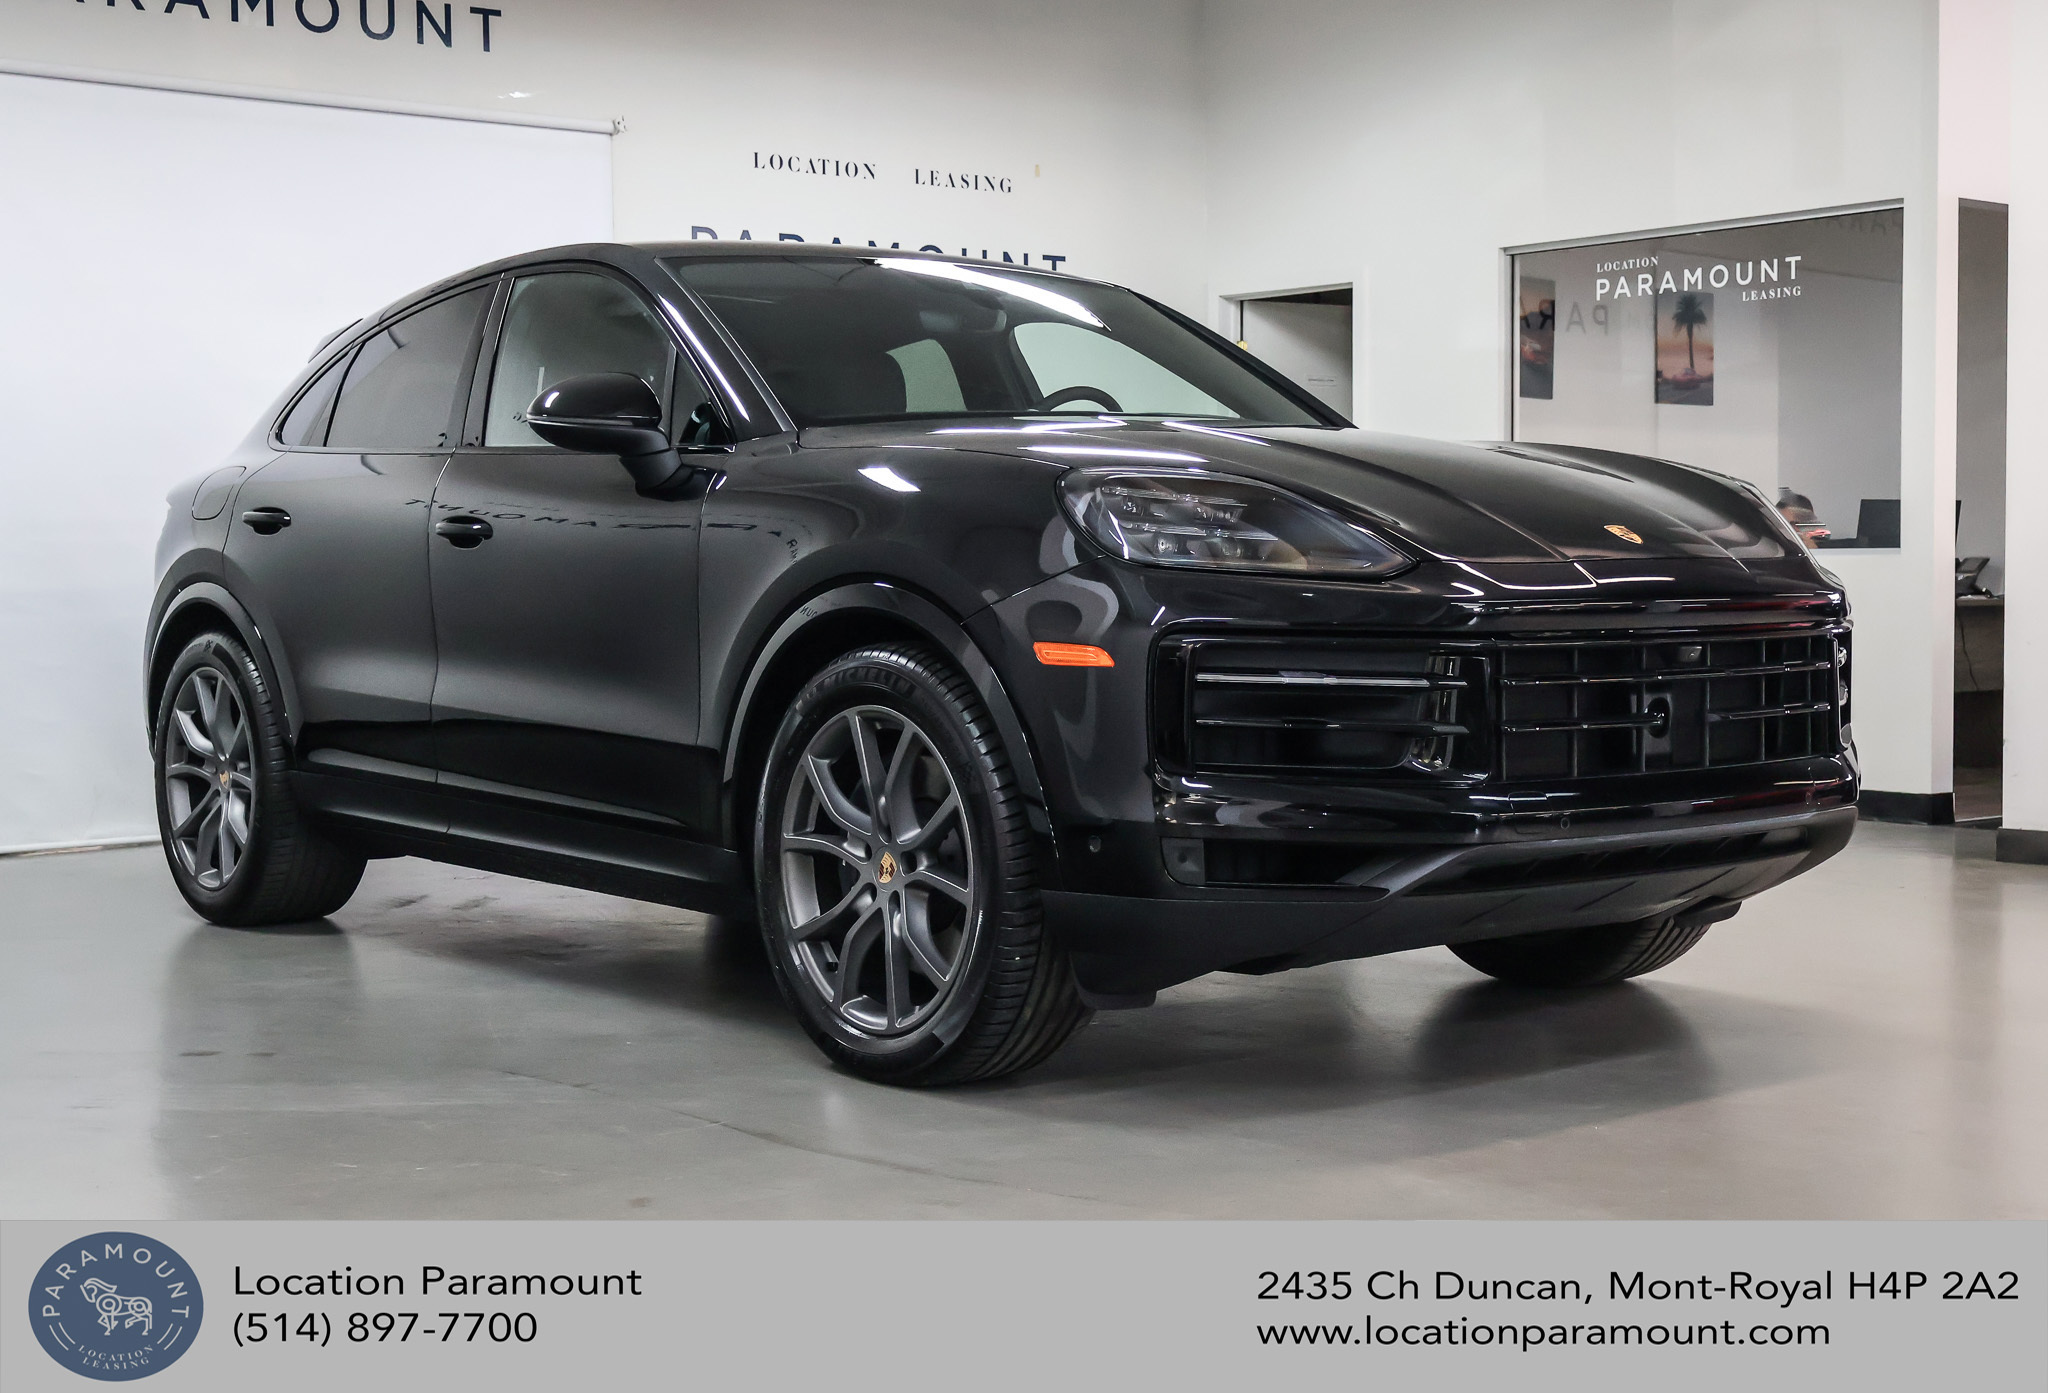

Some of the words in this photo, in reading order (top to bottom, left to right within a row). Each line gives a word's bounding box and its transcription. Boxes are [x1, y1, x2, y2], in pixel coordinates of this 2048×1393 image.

[753, 151, 877, 180] LOCATION
[914, 168, 1013, 194] LEASING
[1595, 255, 1802, 301] PARAMOUNT
[1596, 256, 1659, 273] LOCATION
[1742, 286, 1801, 302] LEASING
